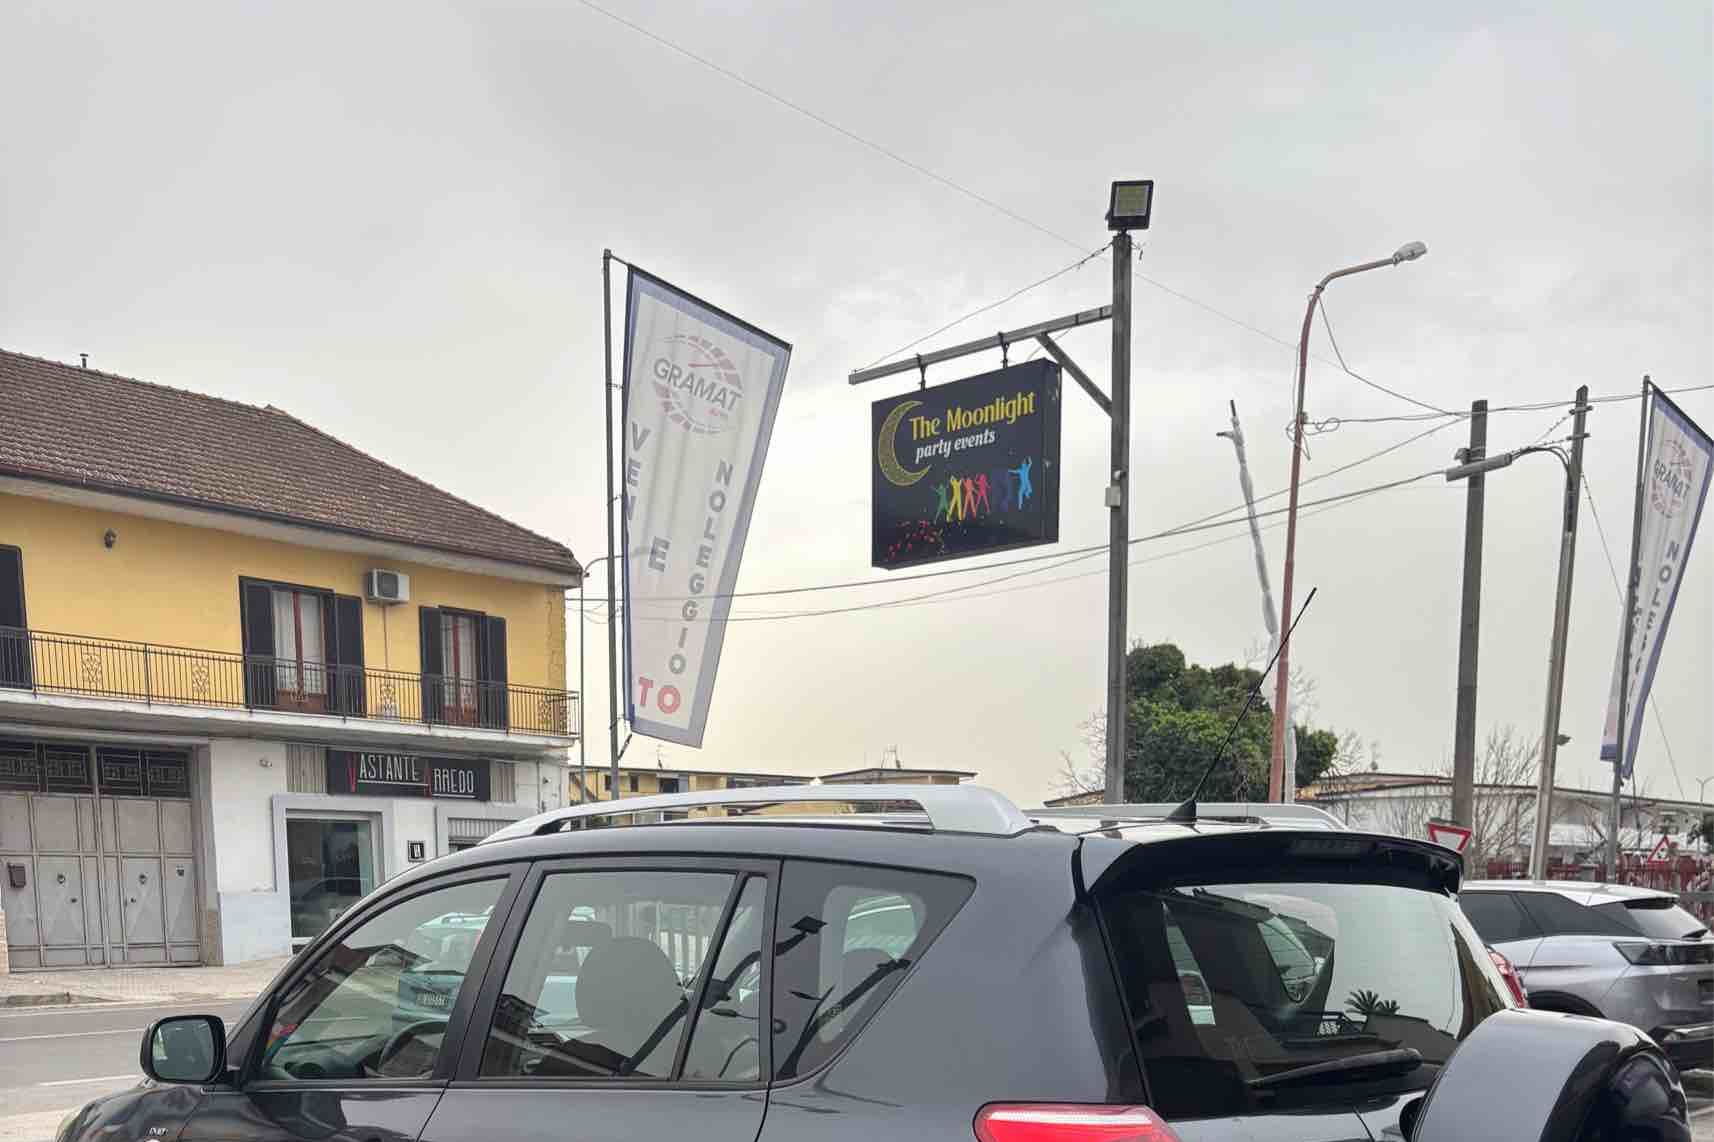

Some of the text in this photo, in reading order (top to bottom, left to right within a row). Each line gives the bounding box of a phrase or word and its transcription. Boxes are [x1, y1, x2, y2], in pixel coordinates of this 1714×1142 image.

[653, 358, 744, 412] GRAMAT
[910, 391, 1036, 441] The Moonlight
[915, 429, 996, 465] party events
[668, 458, 734, 675] NOLEGGIO
